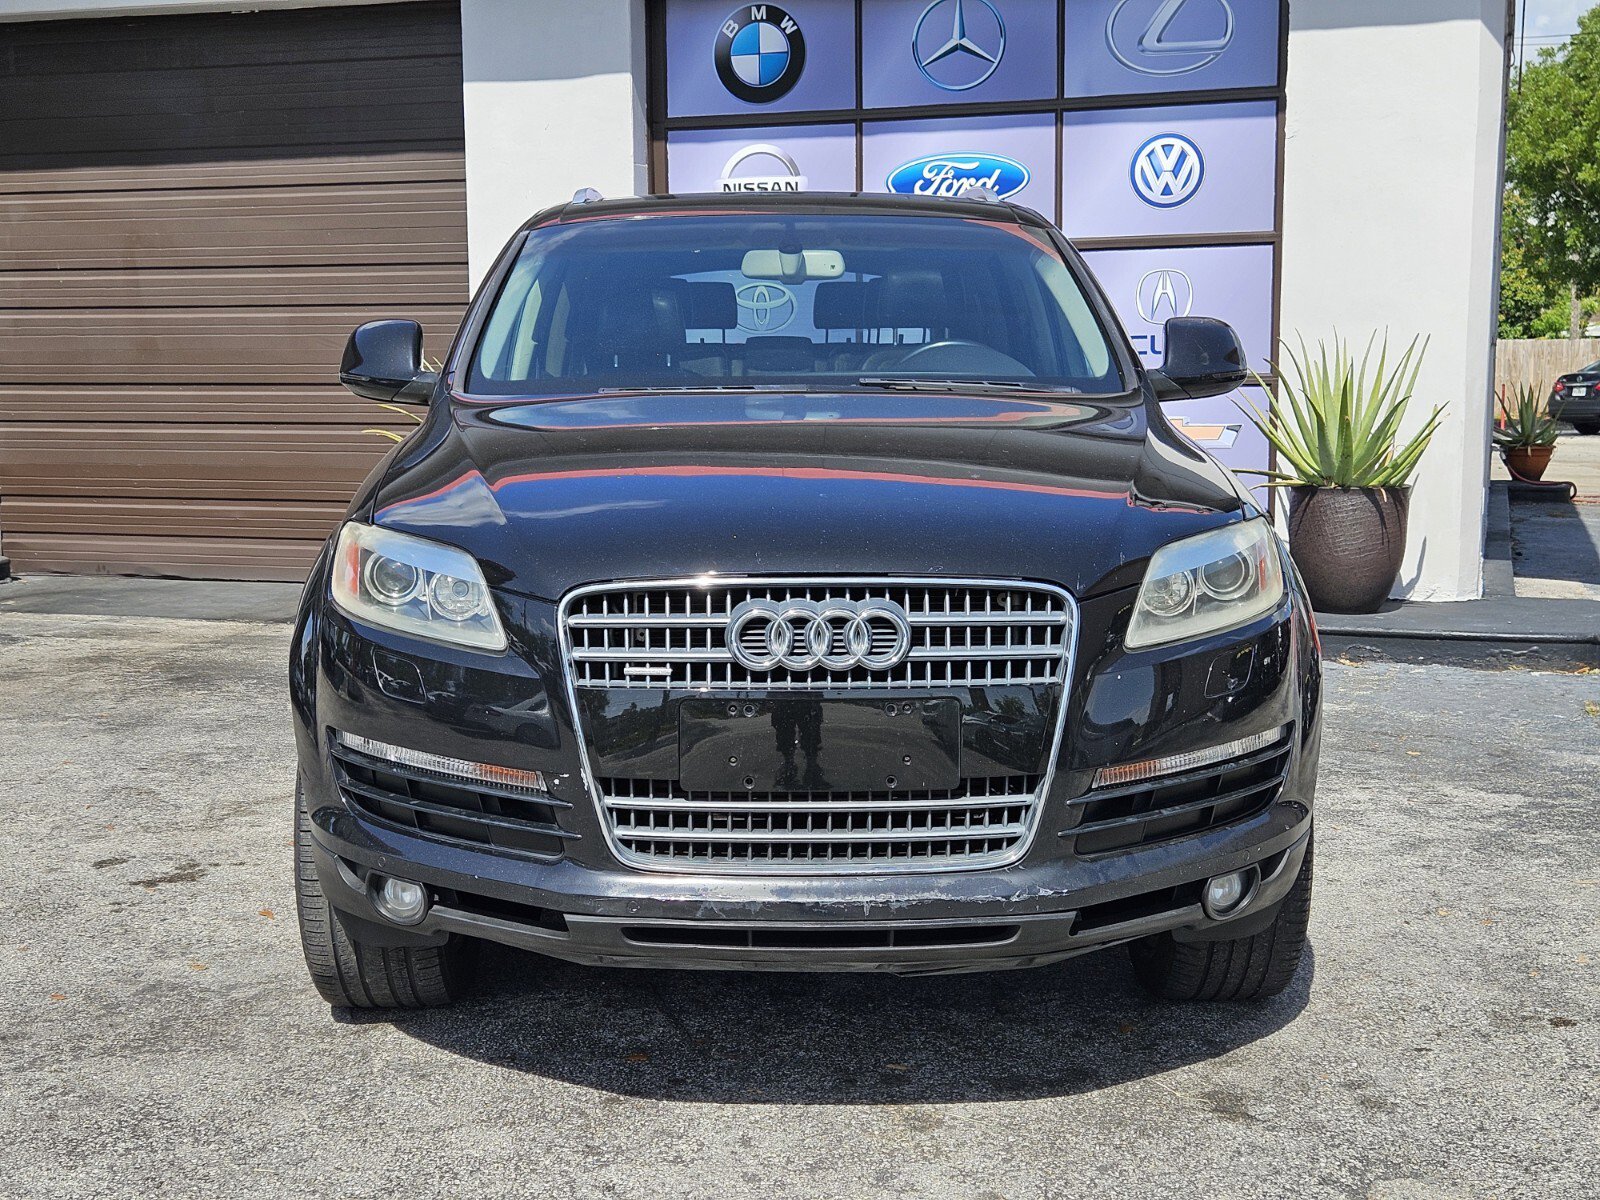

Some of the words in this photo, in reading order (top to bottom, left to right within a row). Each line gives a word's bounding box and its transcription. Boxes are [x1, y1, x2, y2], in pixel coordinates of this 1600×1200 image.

[722, 6, 798, 39] BMW
[723, 181, 799, 192] NISSAN
[914, 161, 1002, 197] Ford
